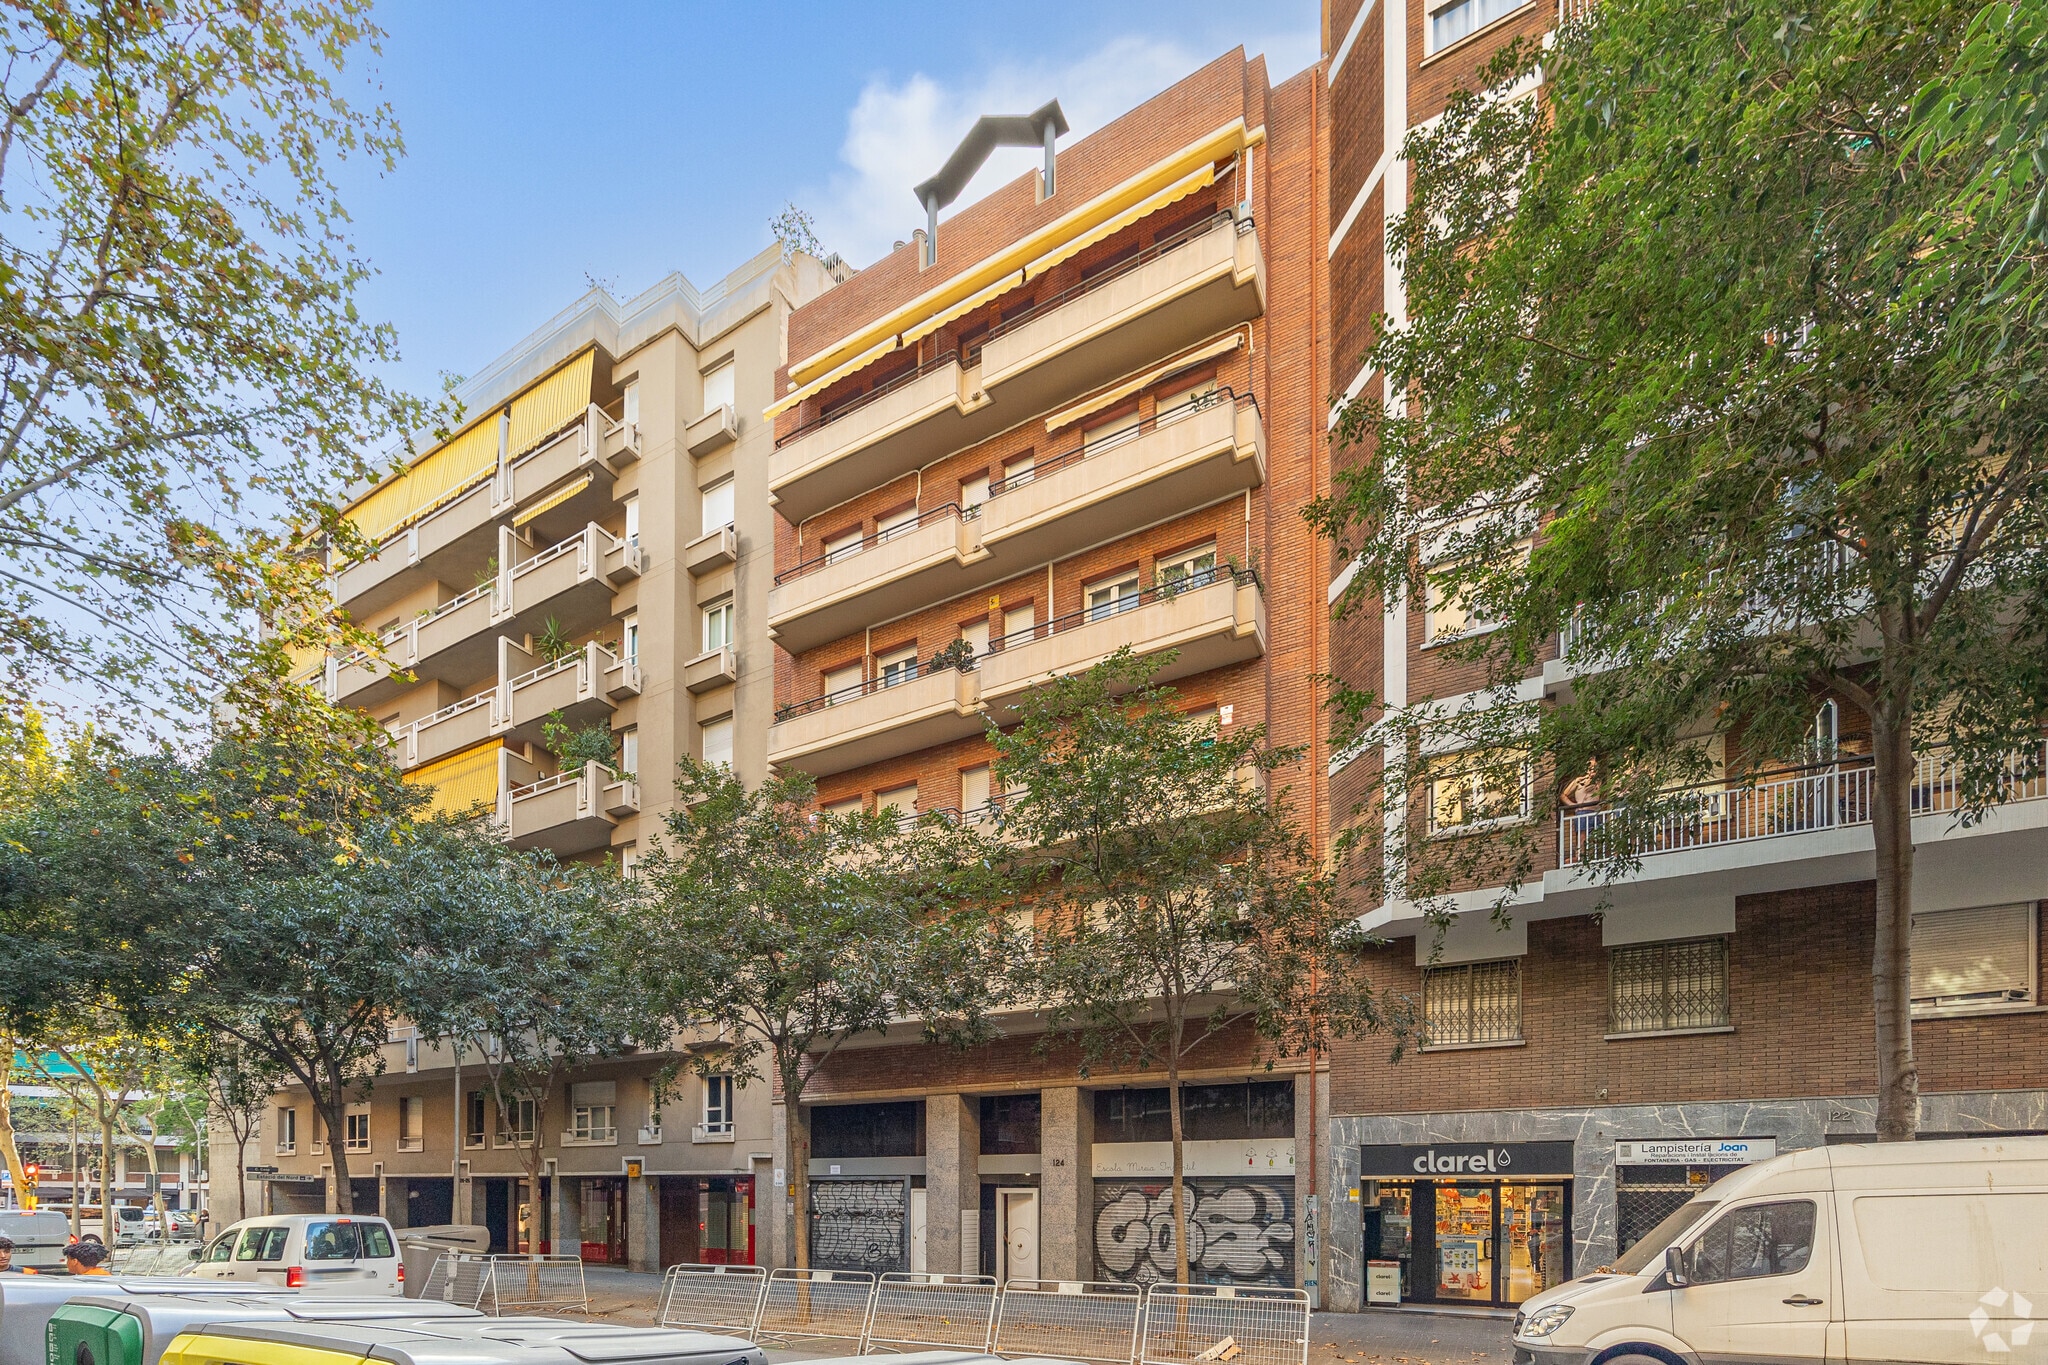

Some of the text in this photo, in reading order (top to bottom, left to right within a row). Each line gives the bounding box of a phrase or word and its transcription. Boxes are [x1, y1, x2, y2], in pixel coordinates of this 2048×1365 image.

[1828, 1111, 1850, 1121] 122
[1641, 1143, 1711, 1154] Lampistería
[1718, 1143, 1748, 1152] Joan
[1052, 1159, 1065, 1167] 124
[1413, 1149, 1497, 1173] clarel
[1096, 1162, 1122, 1172] Escola
